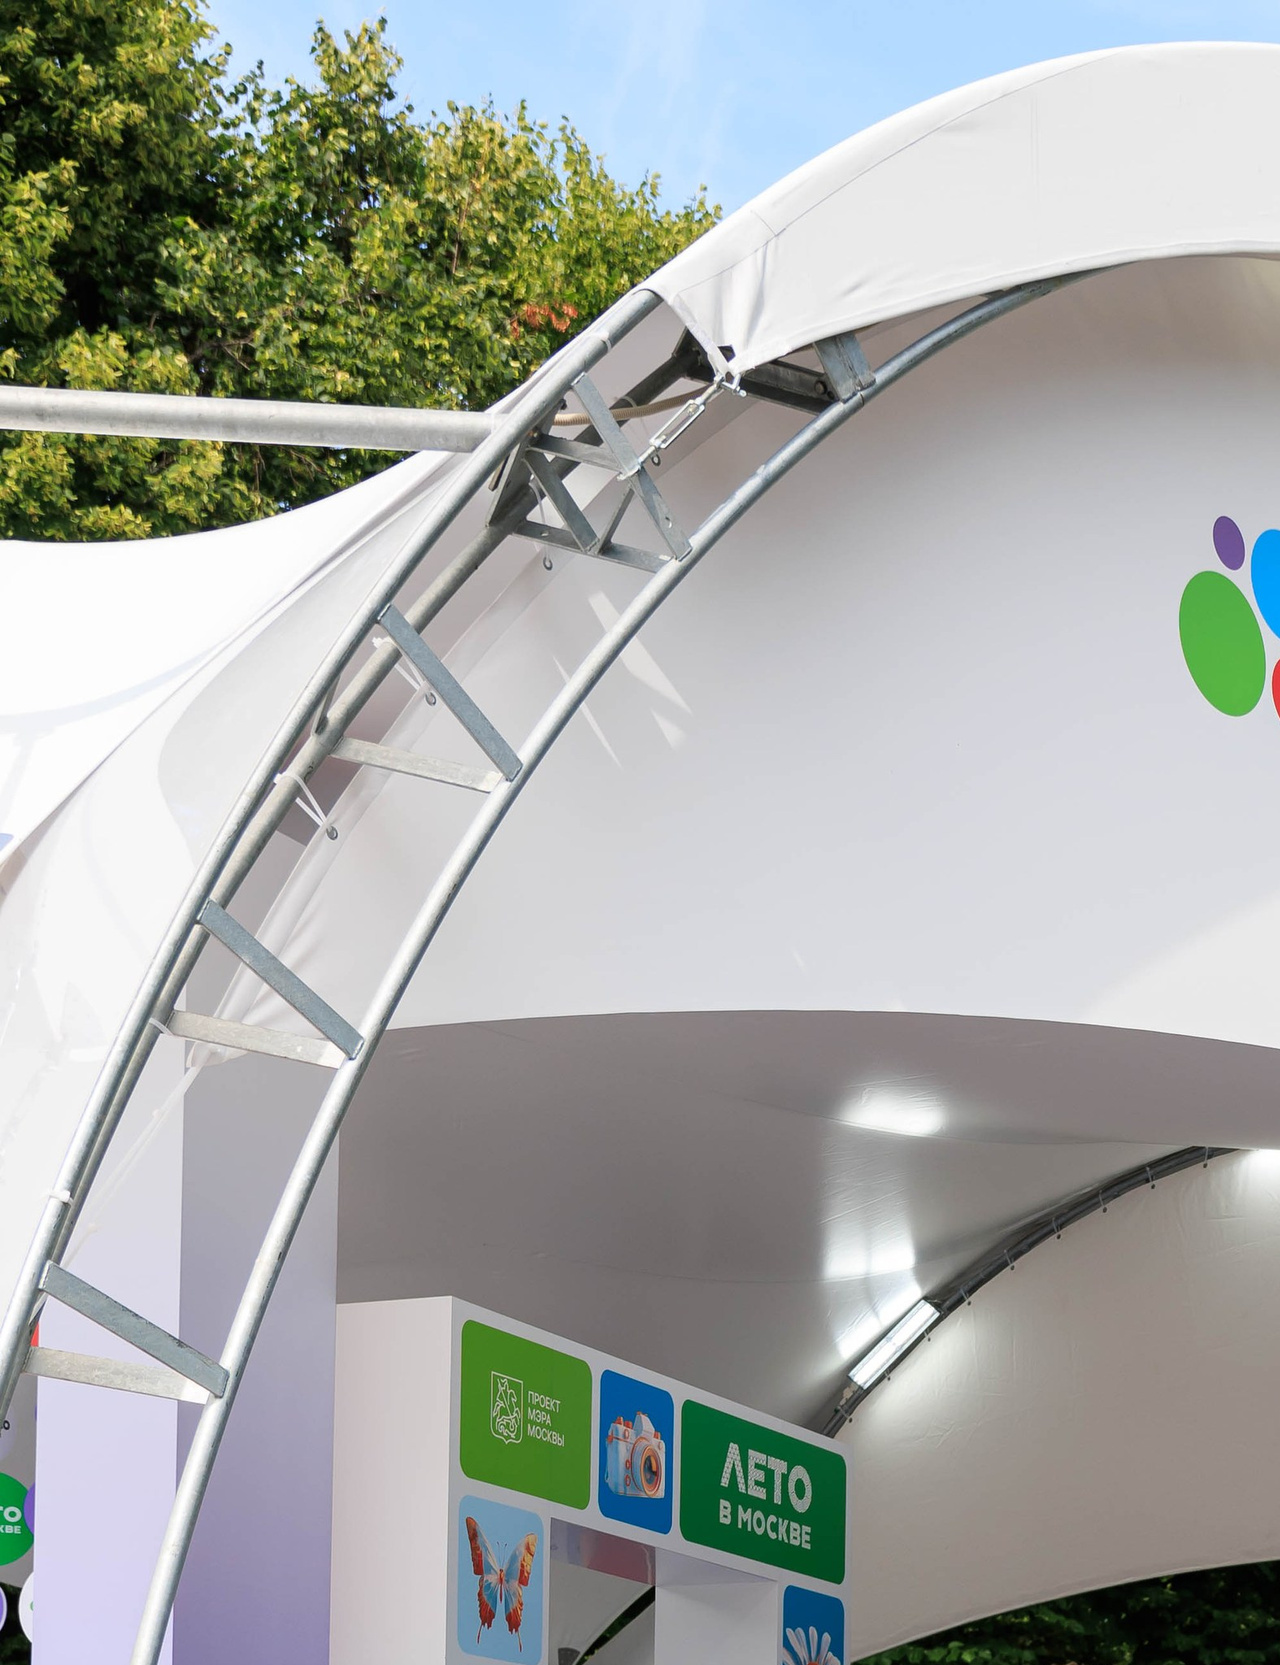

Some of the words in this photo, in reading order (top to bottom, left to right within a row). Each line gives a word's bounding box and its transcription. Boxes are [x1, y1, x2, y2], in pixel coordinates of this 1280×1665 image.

[528, 1391, 561, 1413] ПРОЕКТ
[528, 1407, 552, 1427] МЭРА
[527, 1423, 565, 1447] МОСКВЫ
[720, 1442, 813, 1513] ЛЕТО
[719, 1498, 732, 1525] В
[737, 1504, 811, 1550] МОСКВЕ
